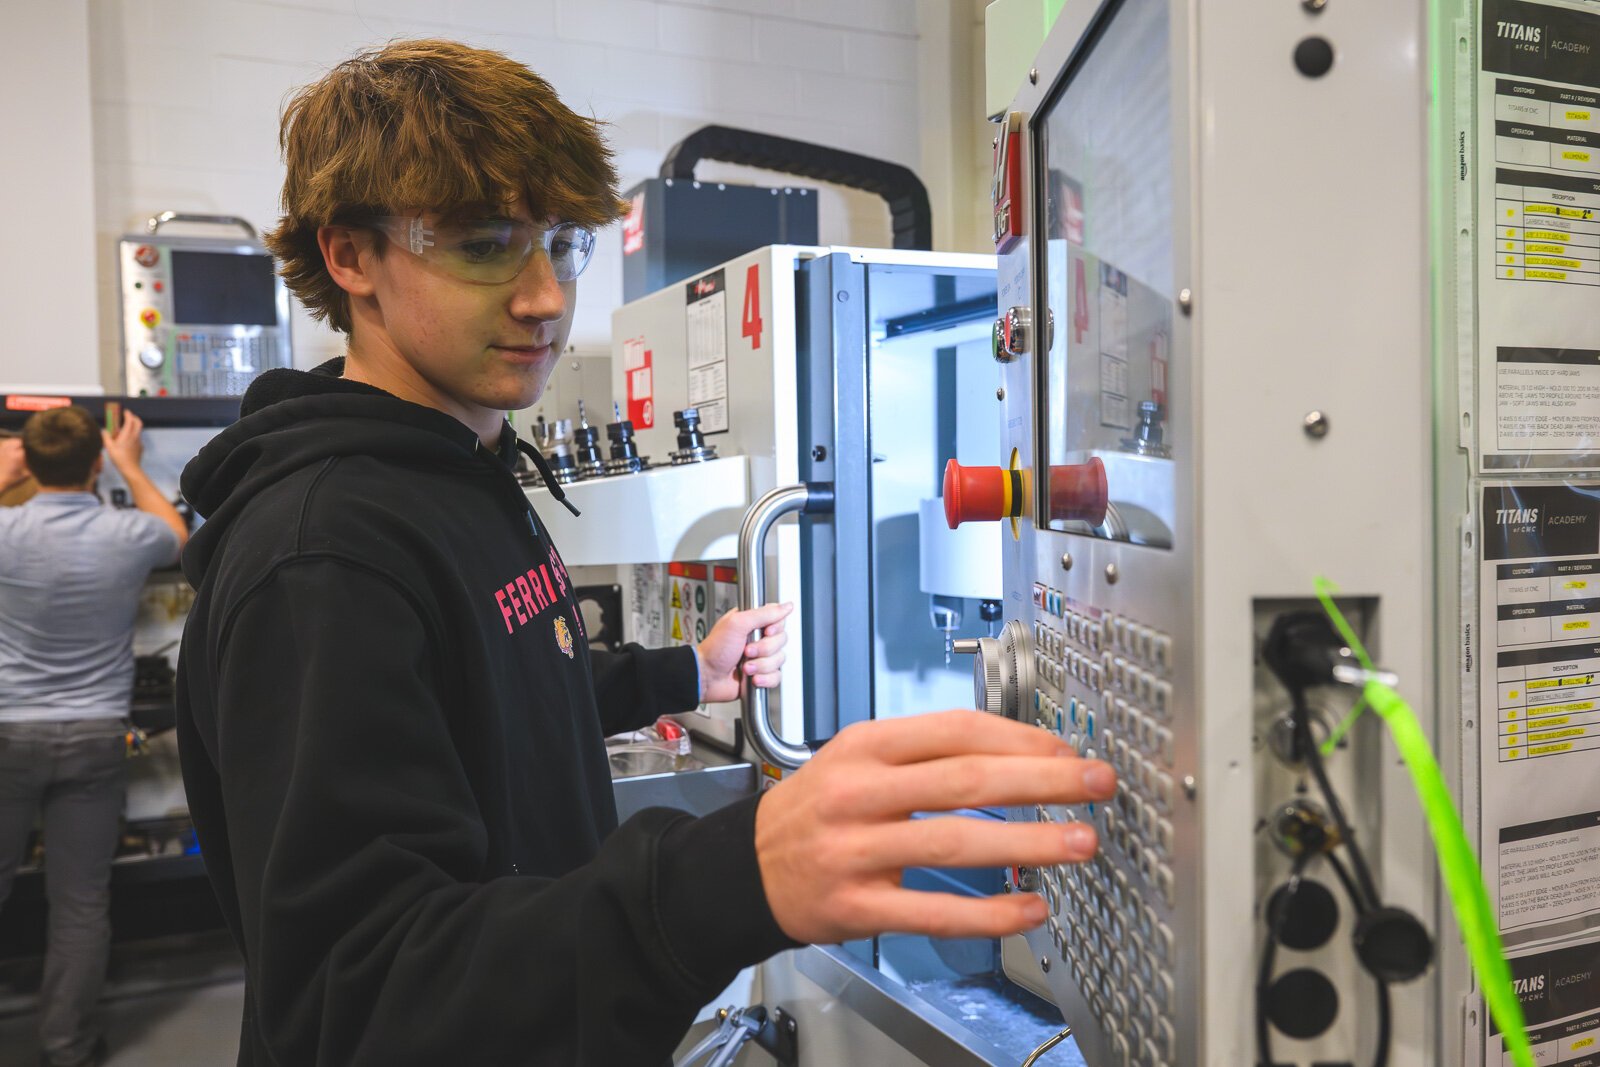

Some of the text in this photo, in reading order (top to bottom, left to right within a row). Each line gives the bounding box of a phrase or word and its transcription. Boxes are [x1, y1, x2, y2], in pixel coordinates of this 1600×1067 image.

[1497, 22, 1541, 42] TITANS
[1524, 44, 1540, 52] CNC
[1551, 40, 1590, 54] ACADEMY
[1513, 86, 1535, 95] CUSTOMER
[1511, 128, 1534, 136] OPERATION
[742, 264, 762, 350] 4
[1496, 508, 1538, 525] TITANS
[1548, 515, 1587, 525] ACADEMY
[1512, 974, 1545, 994] TANS
[1555, 971, 1592, 988] ACADEMY
[1528, 992, 1544, 1000] CNC
